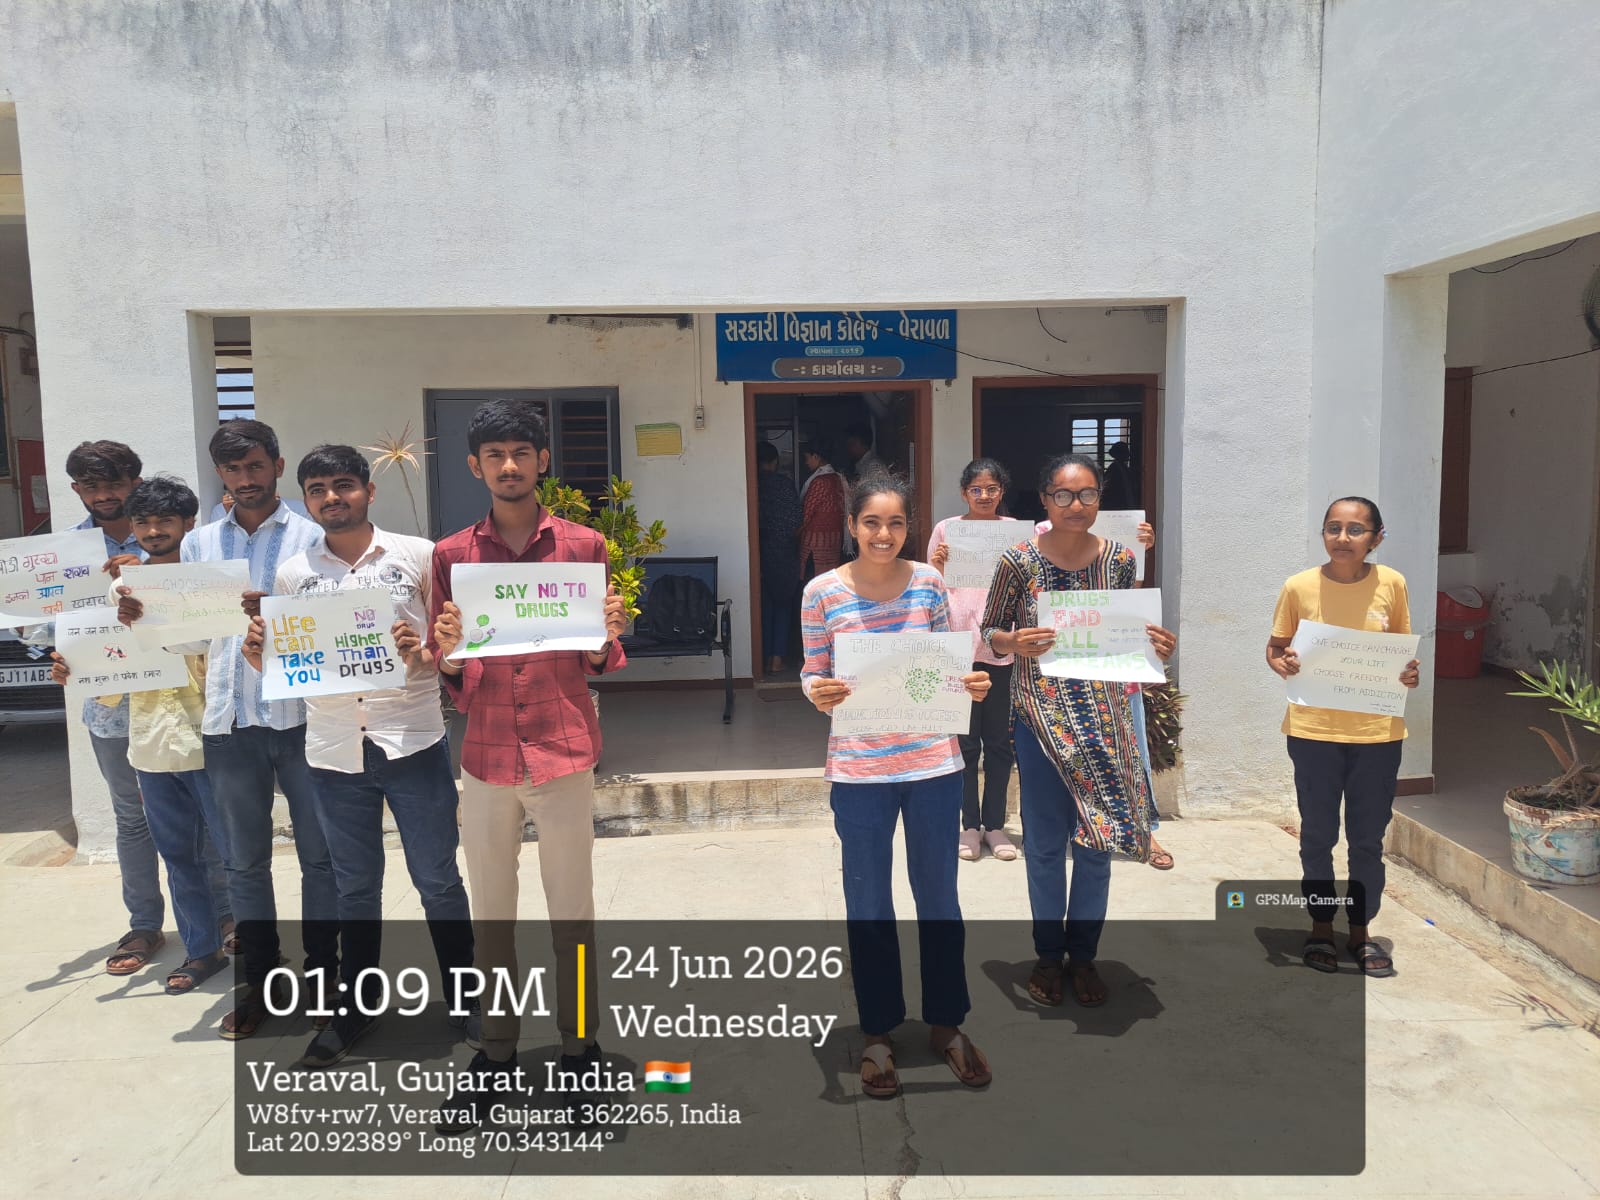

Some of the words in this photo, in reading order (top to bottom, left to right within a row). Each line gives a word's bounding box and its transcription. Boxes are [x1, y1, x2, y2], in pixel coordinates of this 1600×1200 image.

[725, 312, 778, 342] સરકારી
[783, 311, 832, 344] વિજ્ઞાન
[812, 360, 865, 377] કાર્યાલય
[495, 583, 528, 600] SAY
[538, 582, 558, 598] NO
[564, 582, 587, 598] TO
[1050, 591, 1111, 608] DRUGS
[515, 601, 569, 618] DRUGS
[1052, 609, 1102, 628] END
[335, 632, 385, 649] Higher
[1053, 631, 1099, 649] ALL
[337, 645, 388, 663] Than
[340, 658, 395, 678] Drugs
